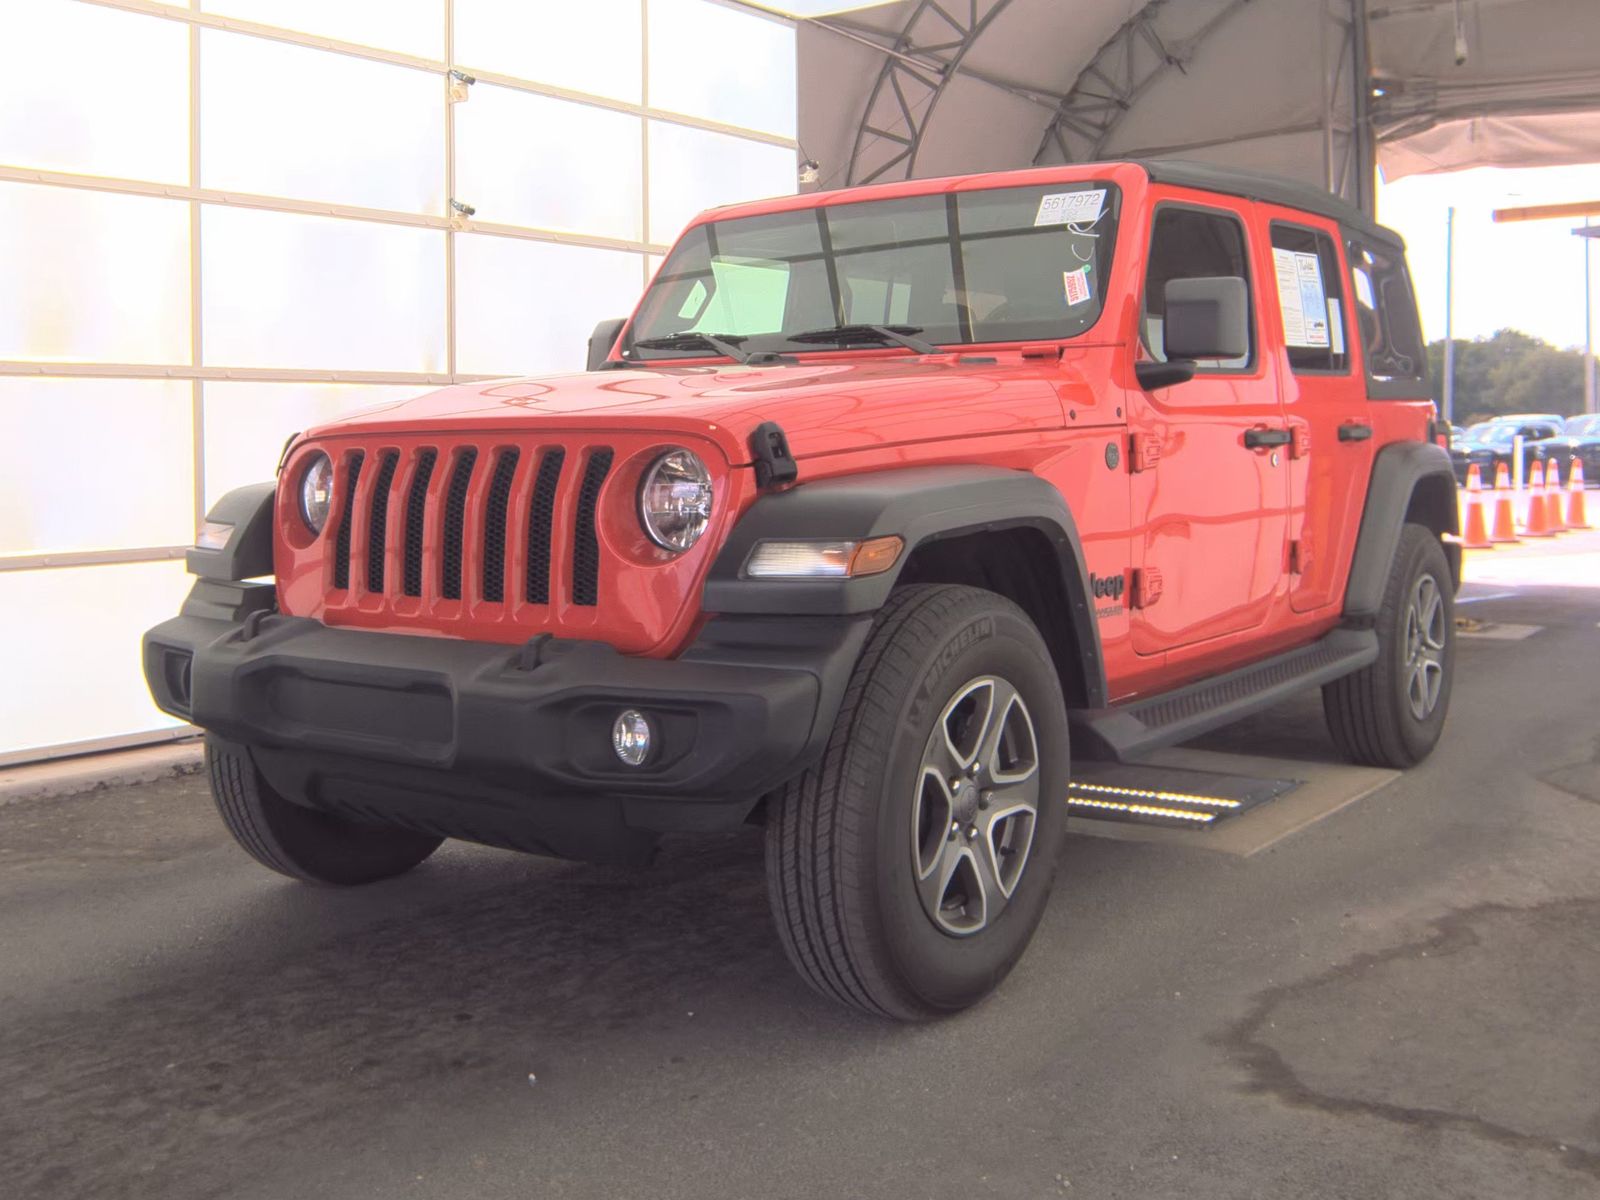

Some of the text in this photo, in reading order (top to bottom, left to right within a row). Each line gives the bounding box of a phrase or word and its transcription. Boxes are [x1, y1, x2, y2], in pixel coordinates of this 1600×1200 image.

[1043, 193, 1100, 210] 5617972
[1090, 571, 1124, 601] Jeep
[924, 618, 992, 696] MICHELIN
